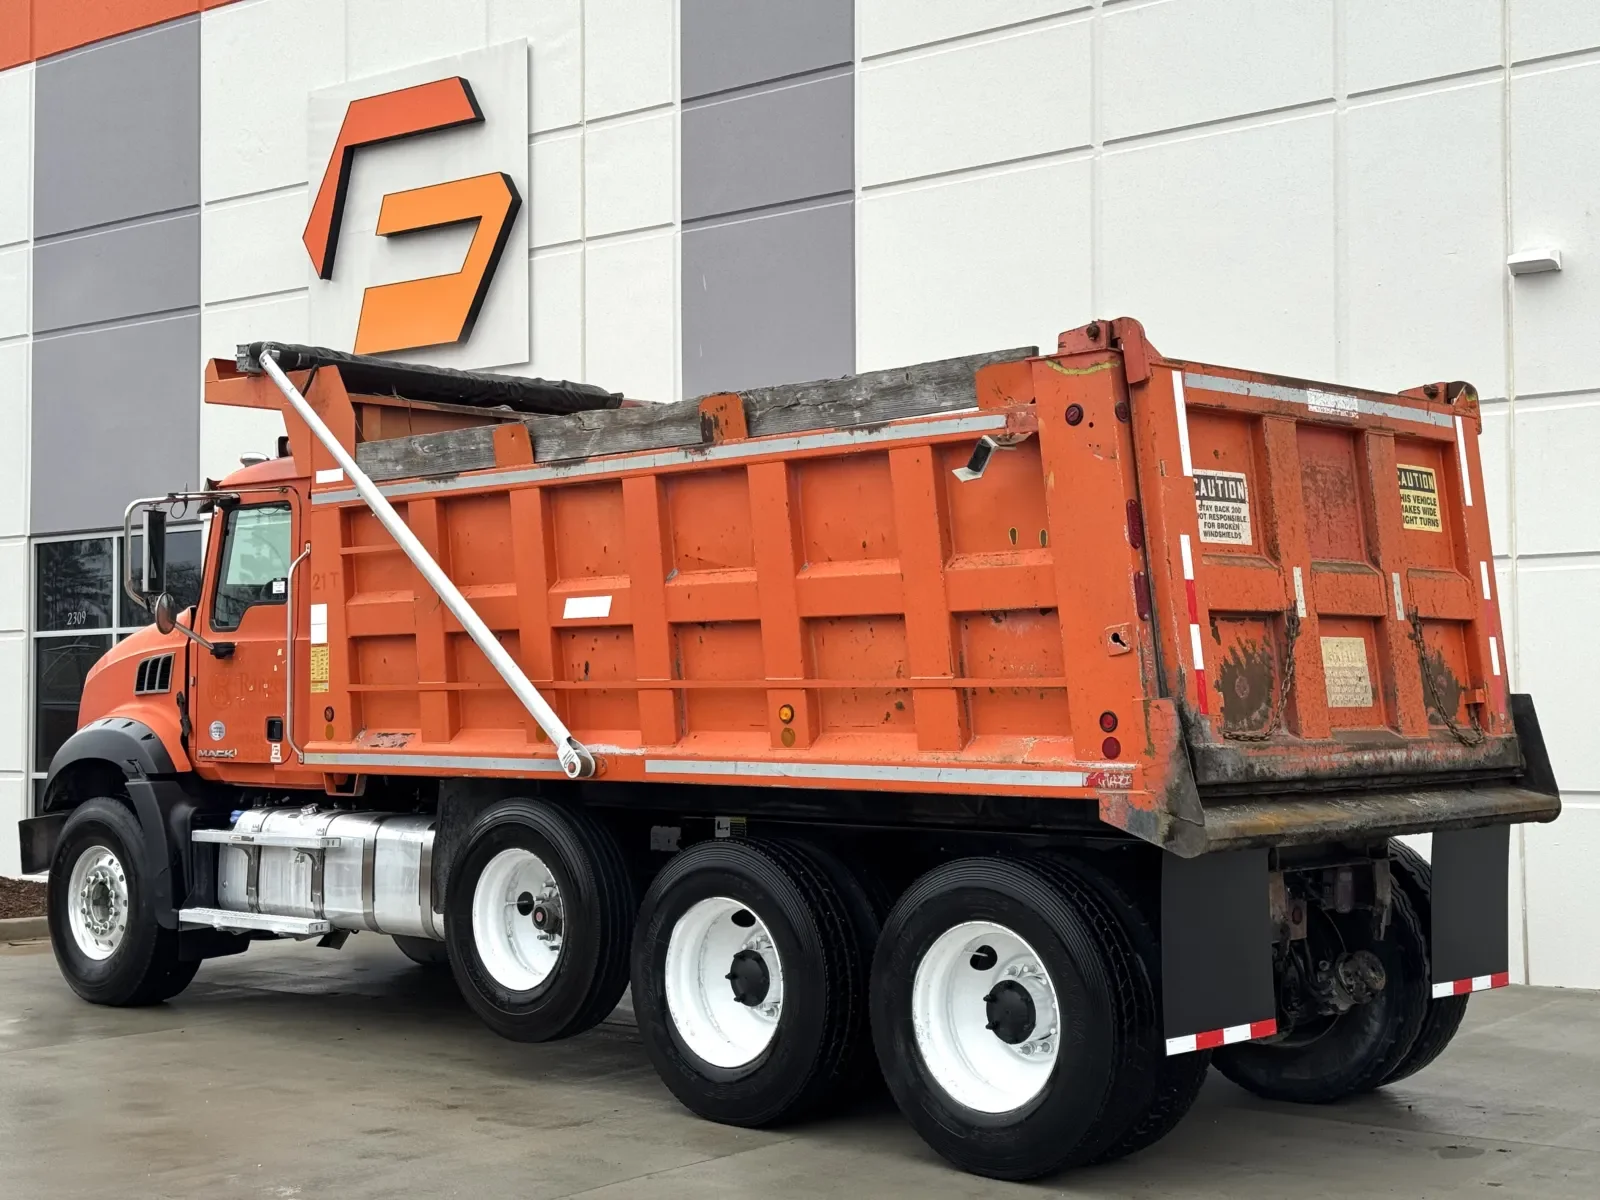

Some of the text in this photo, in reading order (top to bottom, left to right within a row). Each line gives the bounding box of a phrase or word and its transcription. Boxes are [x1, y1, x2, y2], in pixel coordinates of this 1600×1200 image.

[1398, 471, 1435, 490] AUTION
[1400, 493, 1437, 507] HIS VEHICLE
[1198, 504, 1213, 512] STAY
[1214, 505, 1230, 513] BACK
[1422, 506, 1437, 517] WIDE
[1208, 513, 1247, 523] RESPONSIBLE
[1403, 515, 1440, 528] IGHT TURNS
[1204, 521, 1240, 530] FOR BROKEN
[1203, 530, 1242, 539] WINDSHIELDS
[66, 610, 87, 626] 2309
[198, 748, 235, 759] MACK
